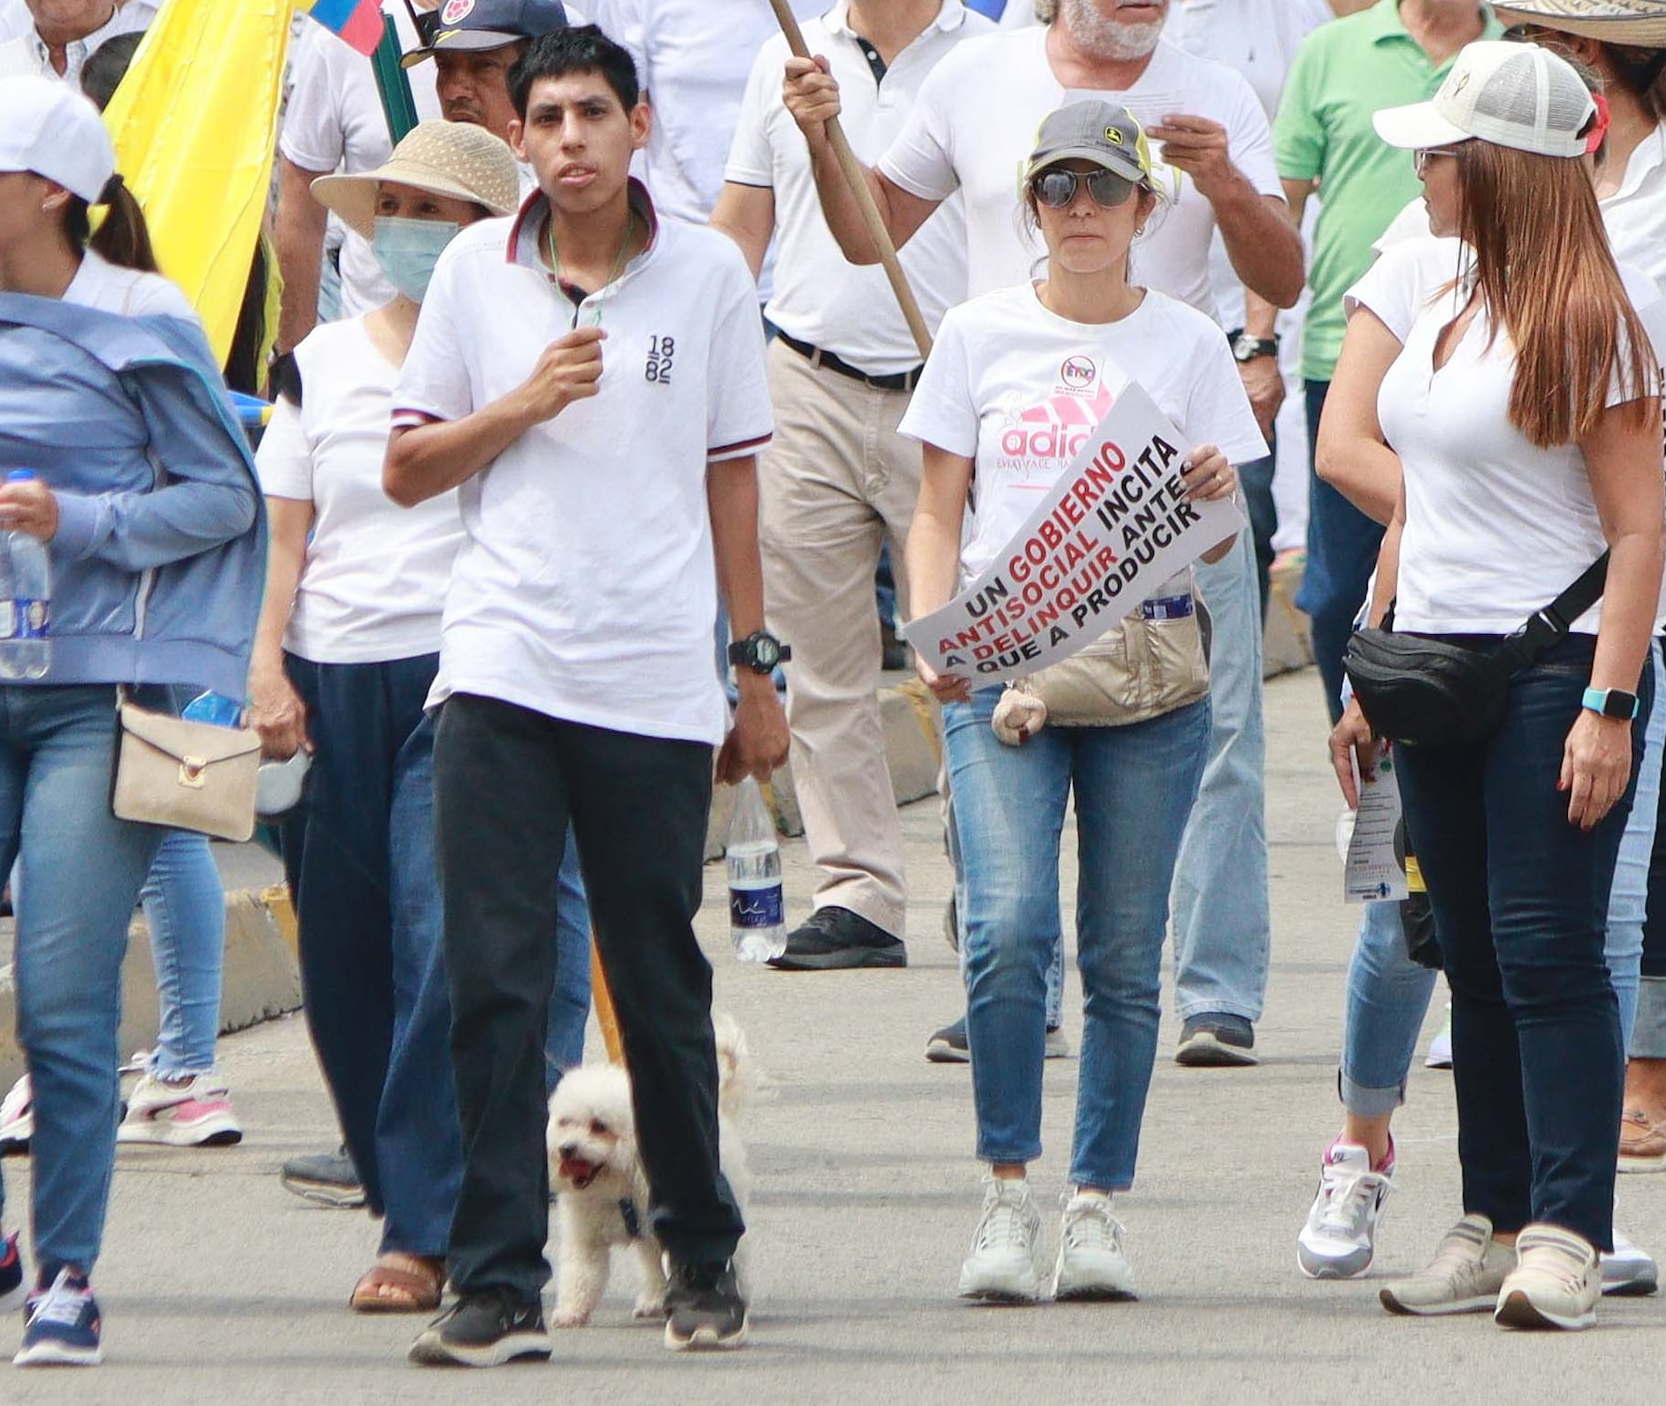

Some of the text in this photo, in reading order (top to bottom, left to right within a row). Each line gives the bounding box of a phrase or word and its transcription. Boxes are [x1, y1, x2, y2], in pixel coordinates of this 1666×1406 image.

[938, 433, 1179, 655] ANTISOCIAL INCITA
[944, 654, 967, 669] A
[973, 544, 1119, 662] DELINQUIR
[964, 576, 1009, 621] UN
[1008, 440, 1127, 584] GOBIERNO
[976, 500, 1202, 675] QUE A PRODUCIR
